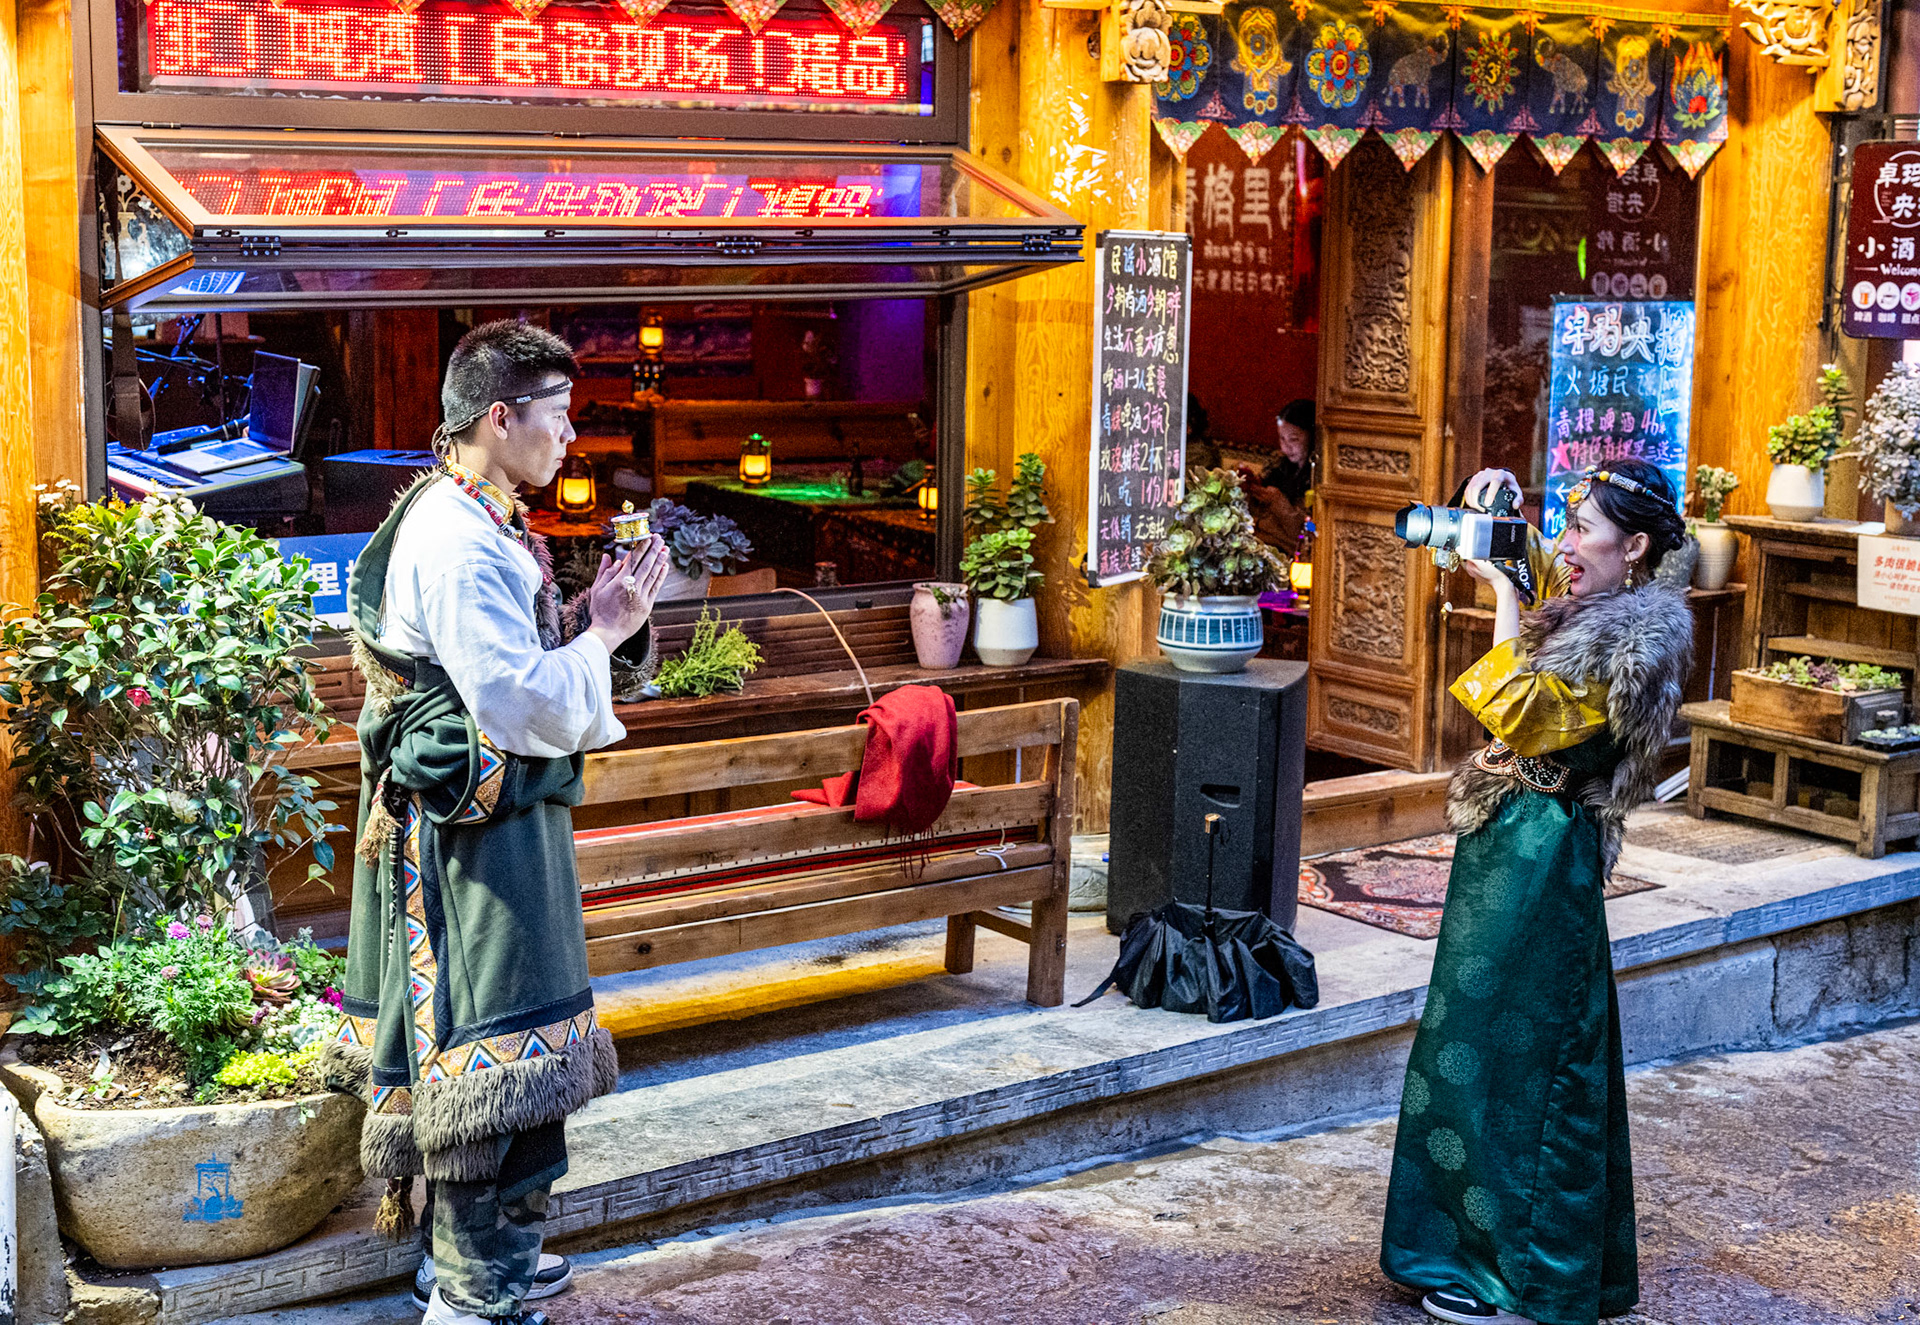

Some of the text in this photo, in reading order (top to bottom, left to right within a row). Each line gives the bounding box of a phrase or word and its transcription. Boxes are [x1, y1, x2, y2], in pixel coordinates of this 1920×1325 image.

[1111, 243, 1178, 280] 民谣小酒馆
[1880, 262, 1920, 277] Welcom
[1105, 283, 1181, 330] 今朝有酒今朝醉
[1874, 555, 1920, 572] 多肉很脆
